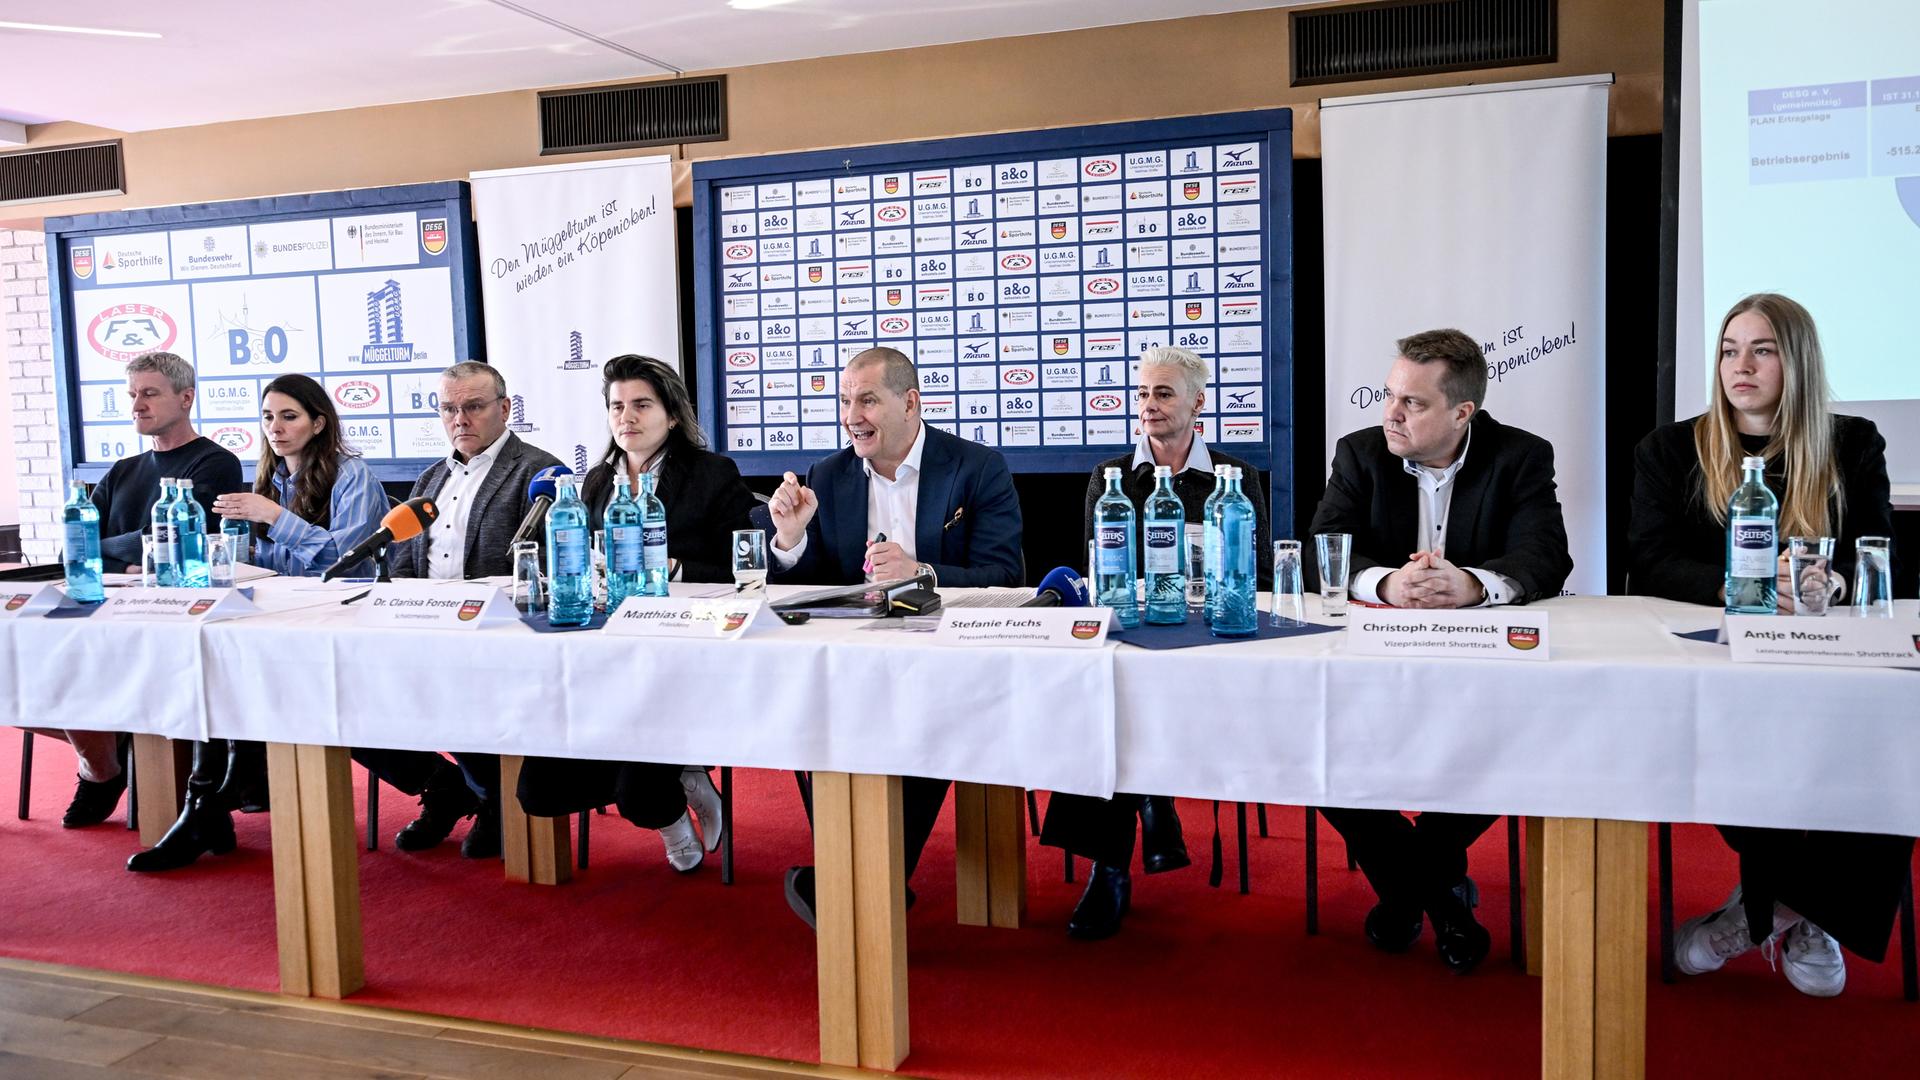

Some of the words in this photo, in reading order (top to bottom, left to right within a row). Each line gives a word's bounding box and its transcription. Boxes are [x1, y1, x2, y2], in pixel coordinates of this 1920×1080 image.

[1750, 117, 1776, 126] PLAN
[1751, 151, 1850, 166] Betriebsergebnis
[1001, 168, 1028, 180] a&o
[764, 215, 788, 227] a&o
[1178, 213, 1206, 226] a&o
[424, 222, 442, 231] DESG
[490, 257, 520, 279] Der
[521, 214, 598, 264] Müggelturm
[601, 199, 617, 220] ist
[516, 264, 554, 294] wieder
[556, 251, 575, 268] ein
[577, 194, 656, 255] Köpenicker!
[272, 240, 329, 252] BUNDESPOLIZEI
[118, 256, 163, 268] Sporthilfe
[188, 254, 232, 264] Bundeswehr
[921, 260, 946, 272] a&o
[1004, 283, 1030, 295] a&o
[100, 304, 164, 322] LASER
[767, 323, 790, 335] a&o
[1180, 333, 1208, 345] a&o
[1502, 325, 1524, 347] ist
[1487, 320, 1576, 382] öpenicker!
[924, 372, 949, 384] a&o
[208, 388, 250, 398] U.G.M.G.
[1006, 397, 1033, 409] a&o
[770, 431, 793, 442] a&o
[1147, 531, 1175, 541] SELTERS
[1736, 530, 1772, 542] SELTERS
[389, 599, 424, 607] Clarissa
[426, 599, 461, 608] Forster
[623, 610, 678, 619] Matthias
[951, 619, 1002, 629] Stefanie
[1006, 619, 1042, 628] Fuchs
[1363, 623, 1427, 635] Christoph
[1431, 623, 1498, 635] Zepernick
[958, 632, 1050, 641] Pressekonferenzleitung
[1744, 630, 1786, 641] Antje
[1791, 631, 1841, 642] Moser
[1384, 640, 1446, 649] Vizepräsident
[1448, 641, 1497, 649] Shorttrack
[1856, 650, 1914, 659] Shorttrack
